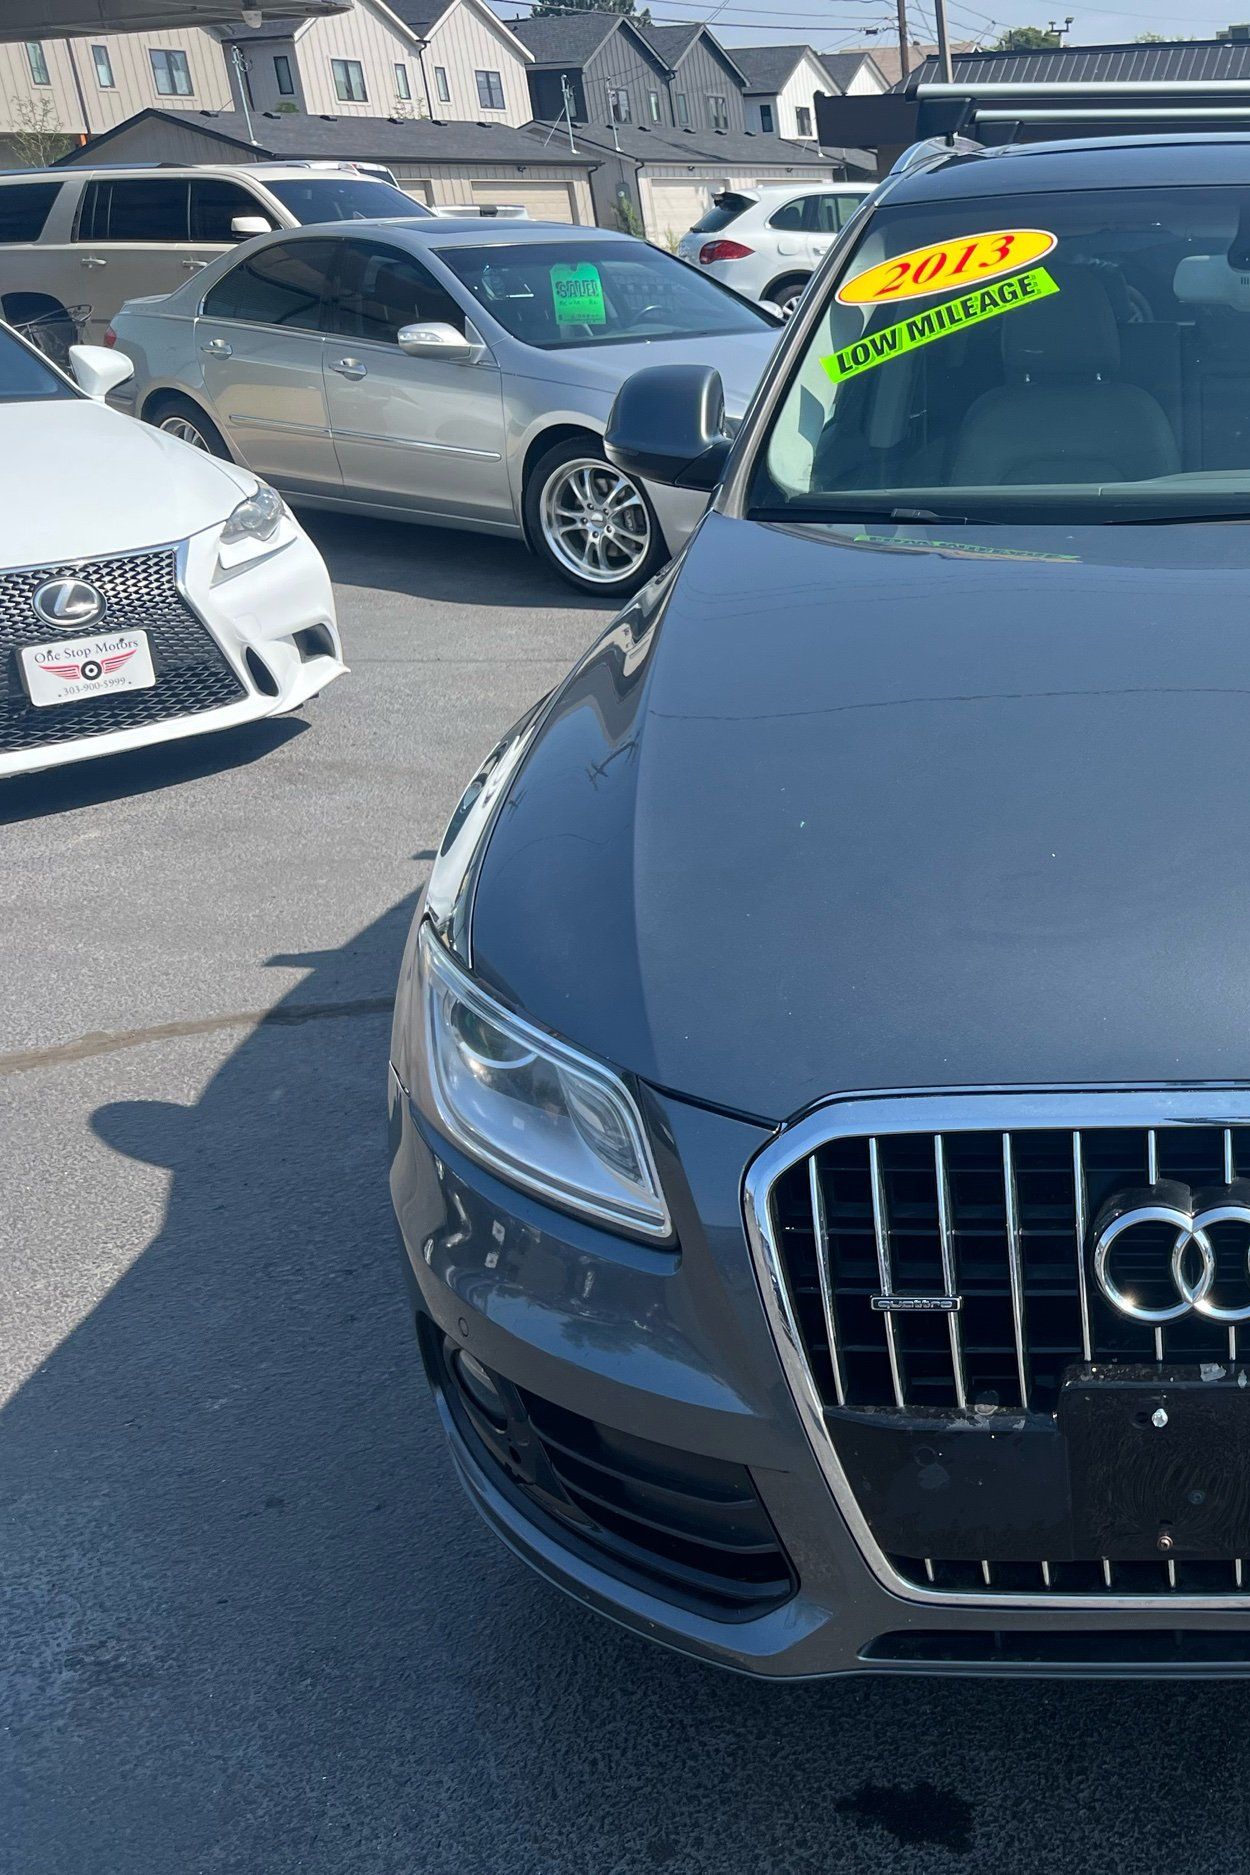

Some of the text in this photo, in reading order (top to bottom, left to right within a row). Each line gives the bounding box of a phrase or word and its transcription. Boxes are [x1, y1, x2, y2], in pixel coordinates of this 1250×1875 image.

[873, 235, 1015, 297] 2013
[836, 274, 1040, 375] LOW MILEAGE
[34, 639, 139, 664] One Stop Motors
[63, 677, 126, 696] 303-900-5999
[877, 1300, 953, 1310] quattro
